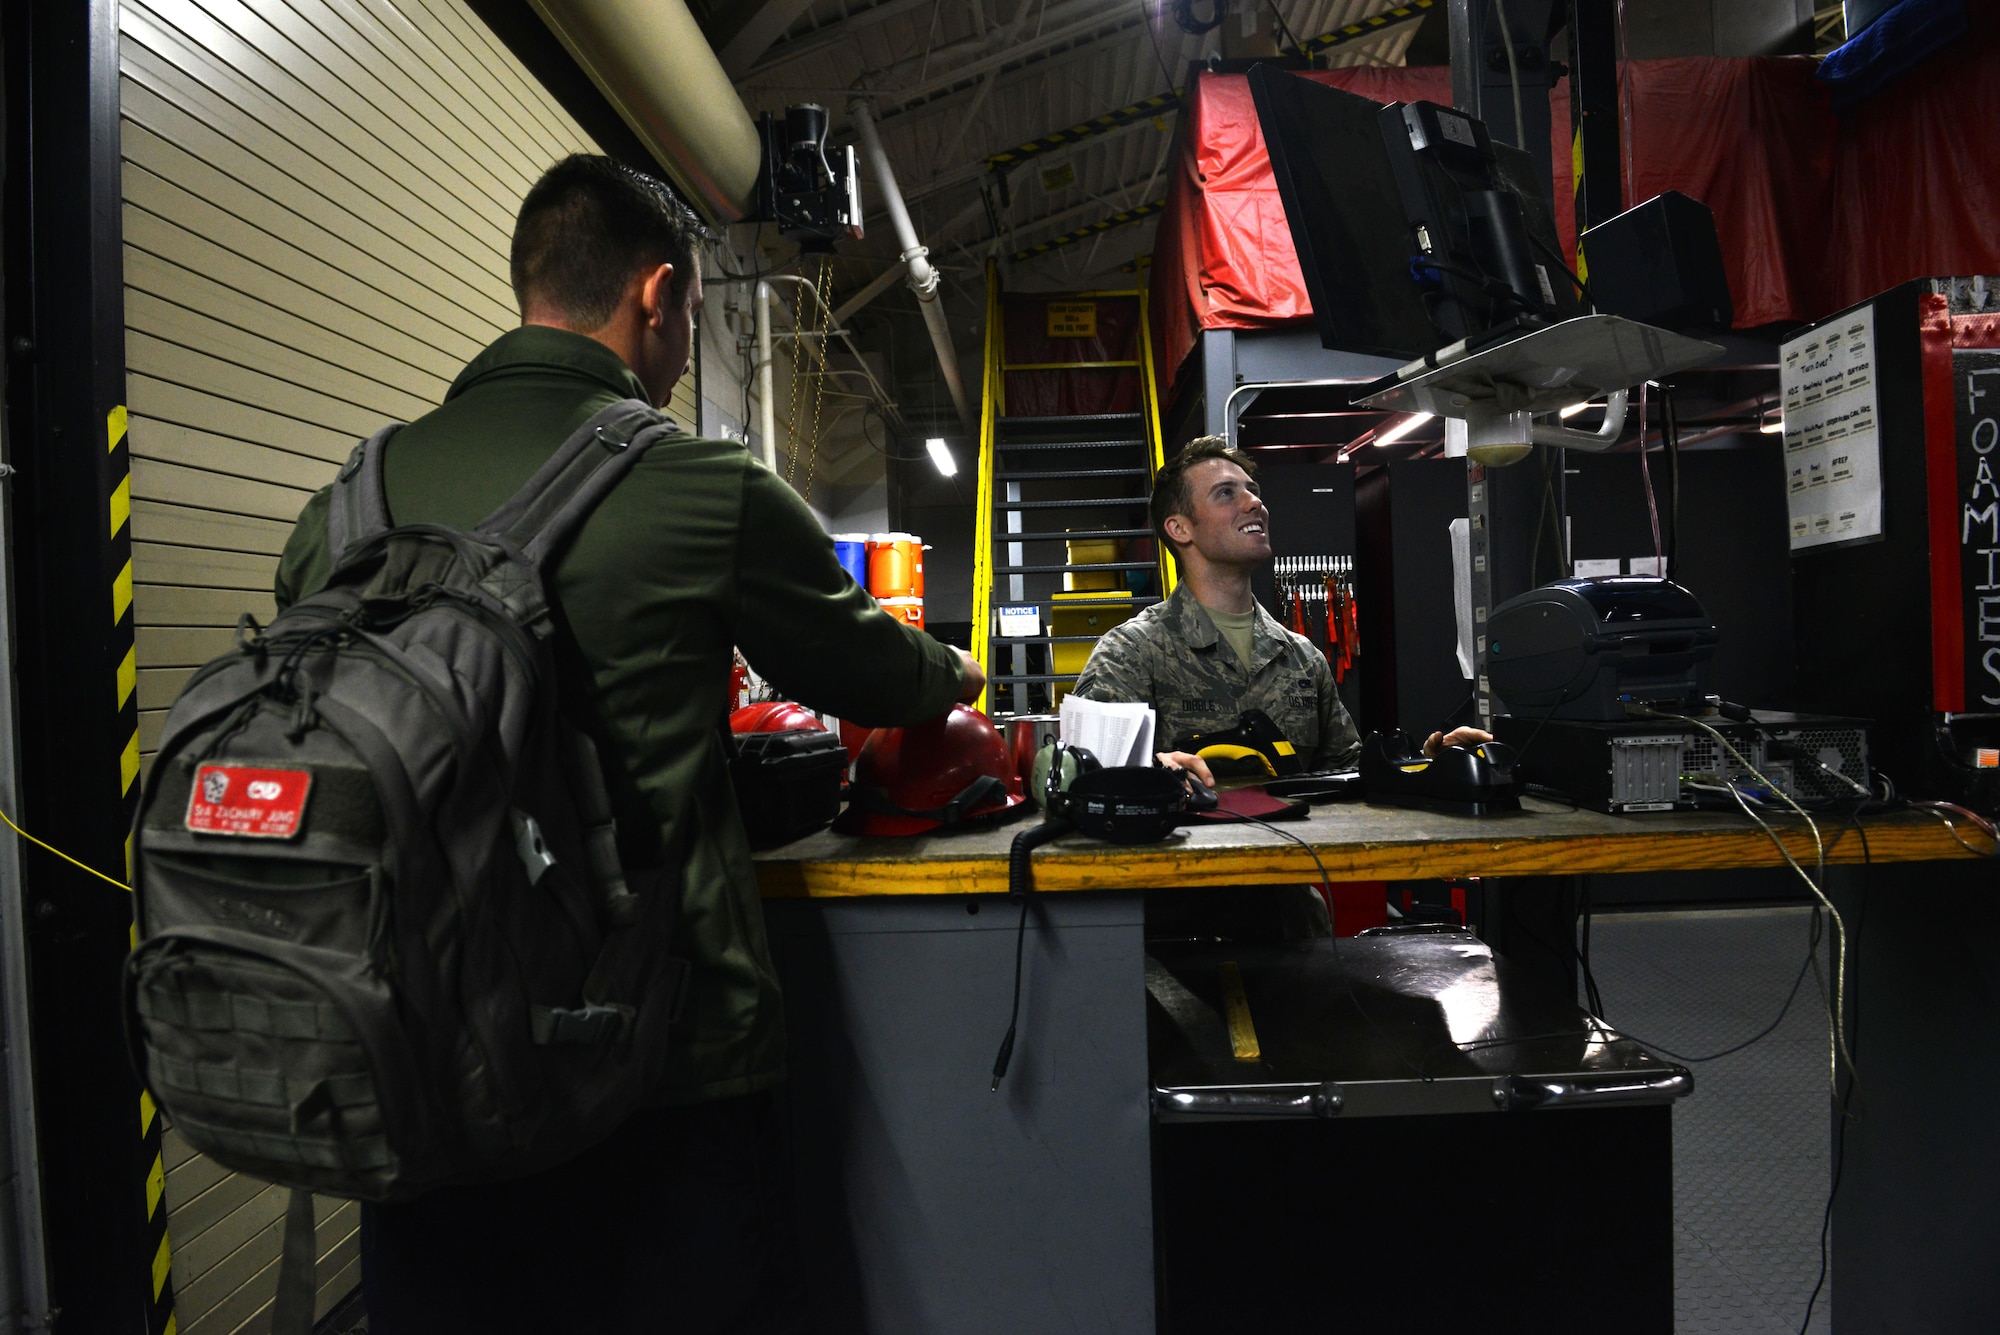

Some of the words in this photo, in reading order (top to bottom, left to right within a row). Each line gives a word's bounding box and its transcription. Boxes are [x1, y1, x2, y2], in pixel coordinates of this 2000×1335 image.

[1962, 368, 2000, 706] FOAMIES
[1005, 607, 1033, 615] NOTICE
[1182, 699, 1216, 712] DIBBLE
